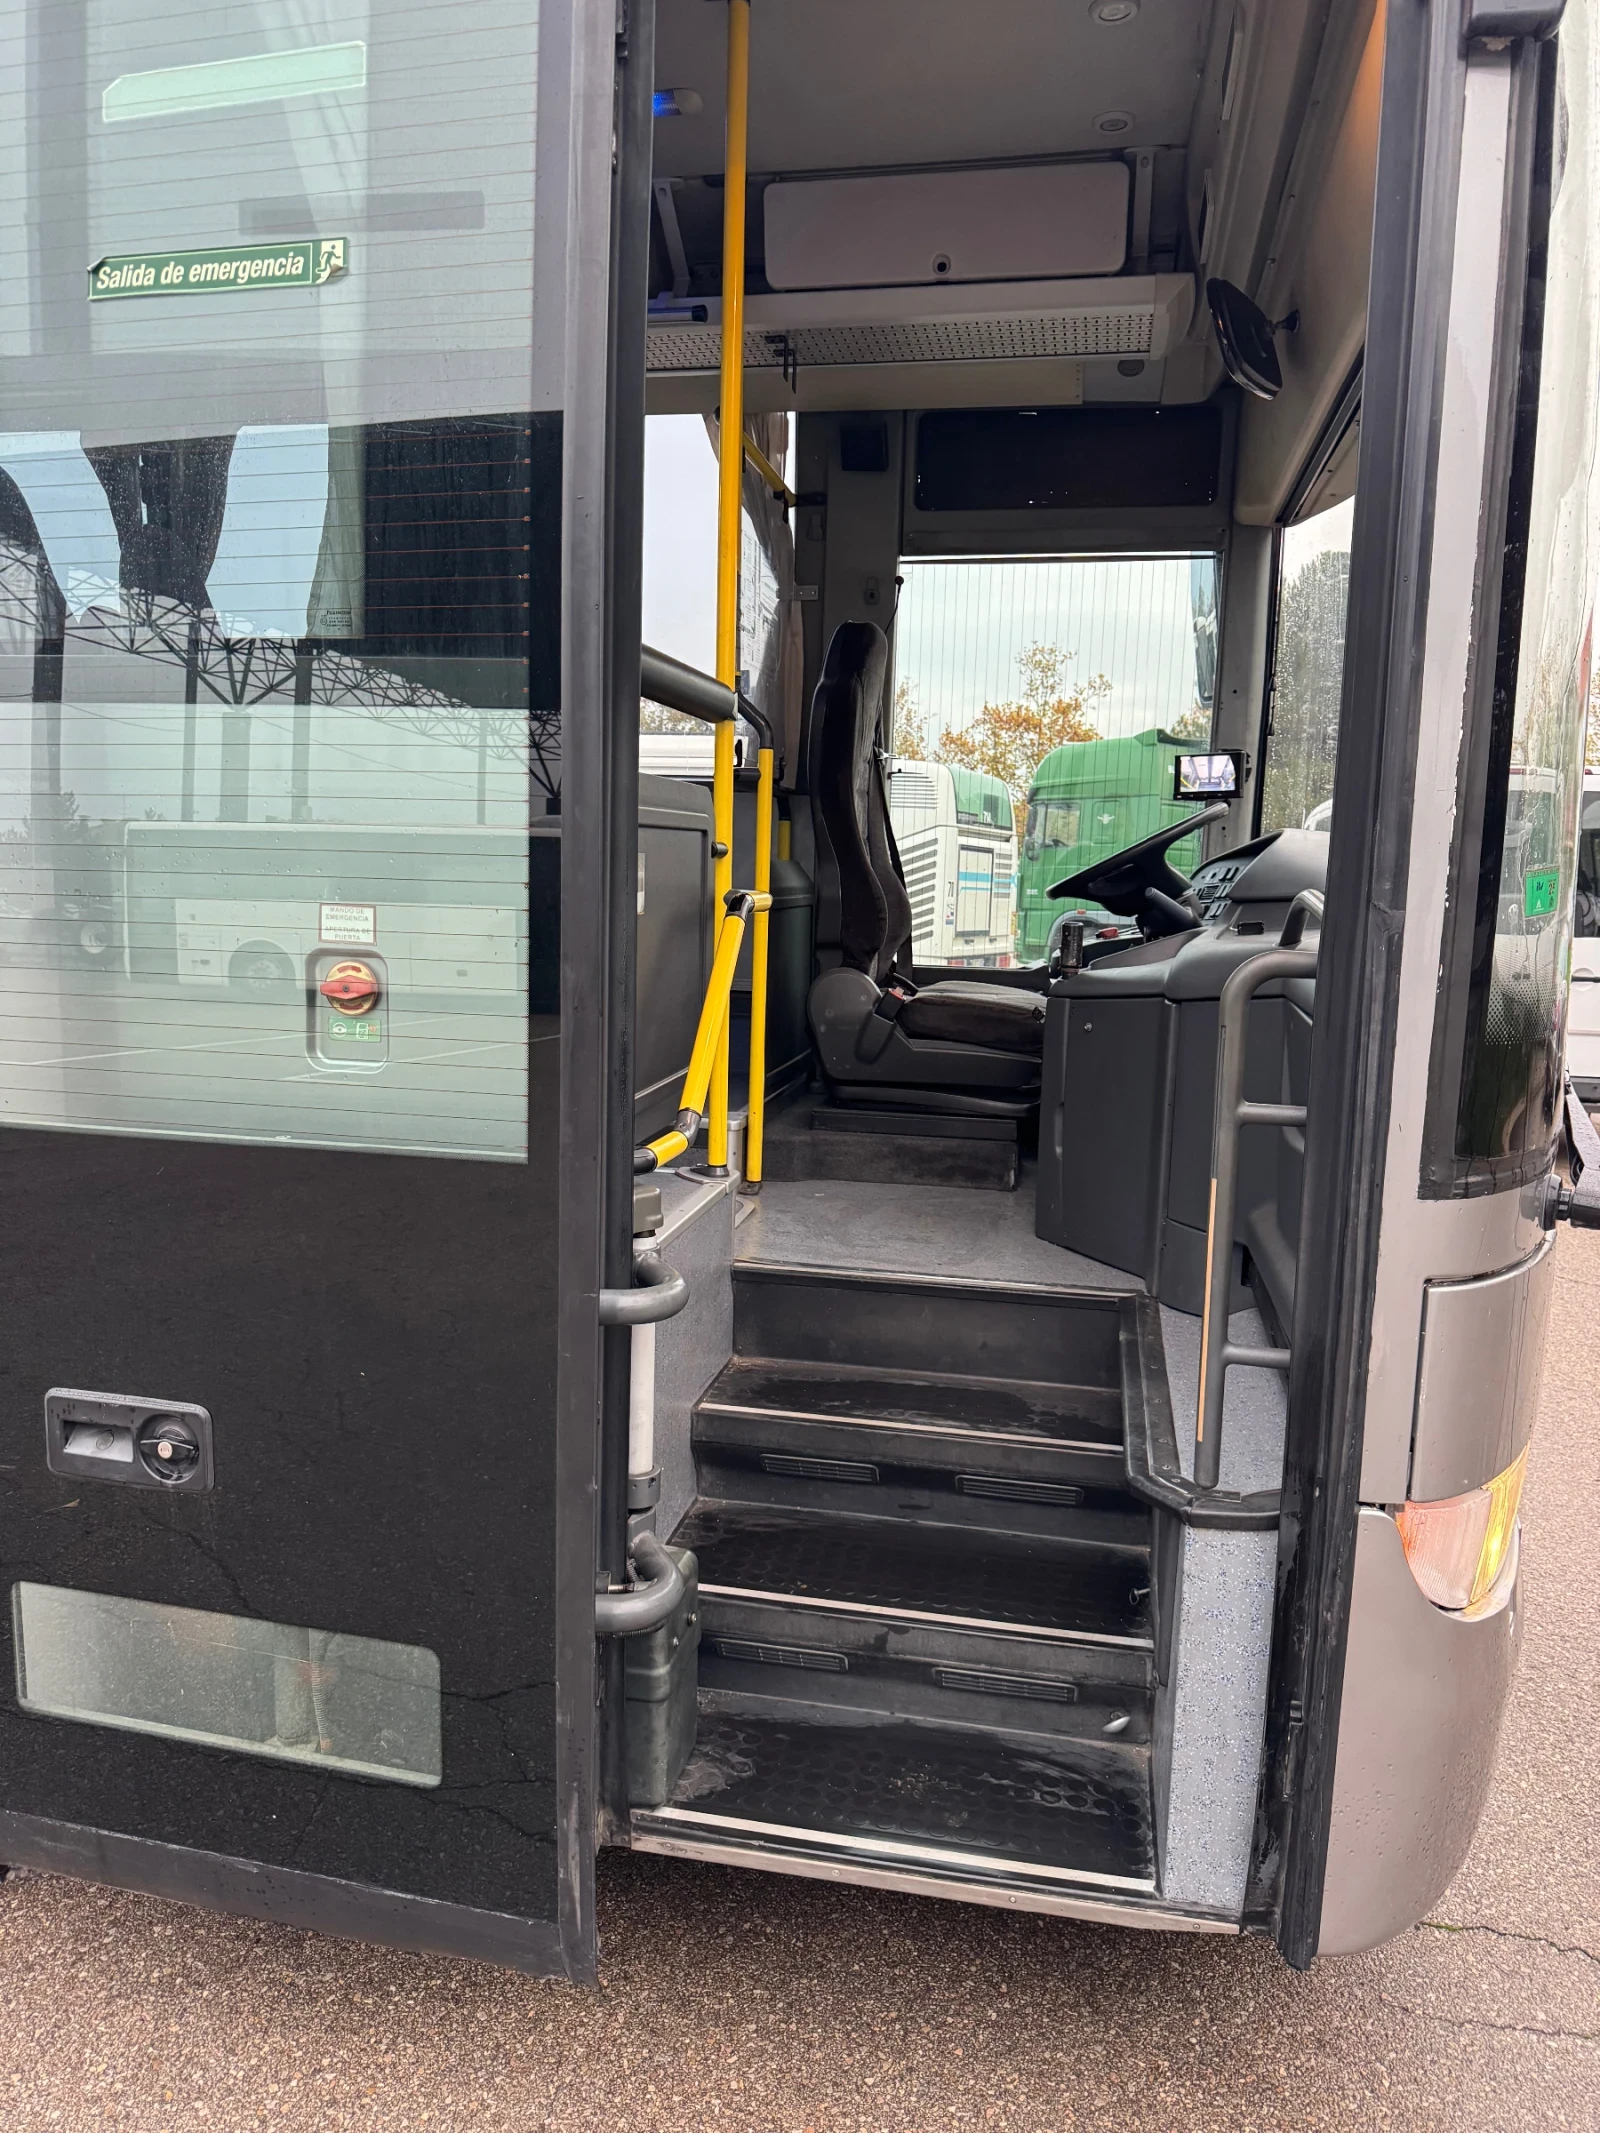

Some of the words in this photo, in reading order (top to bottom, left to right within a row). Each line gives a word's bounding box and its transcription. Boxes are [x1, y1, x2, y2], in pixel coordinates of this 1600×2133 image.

[96, 262, 155, 290] Salida
[160, 260, 185, 285] de
[191, 251, 305, 284] emergencia
[334, 933, 361, 941] PUERTA
